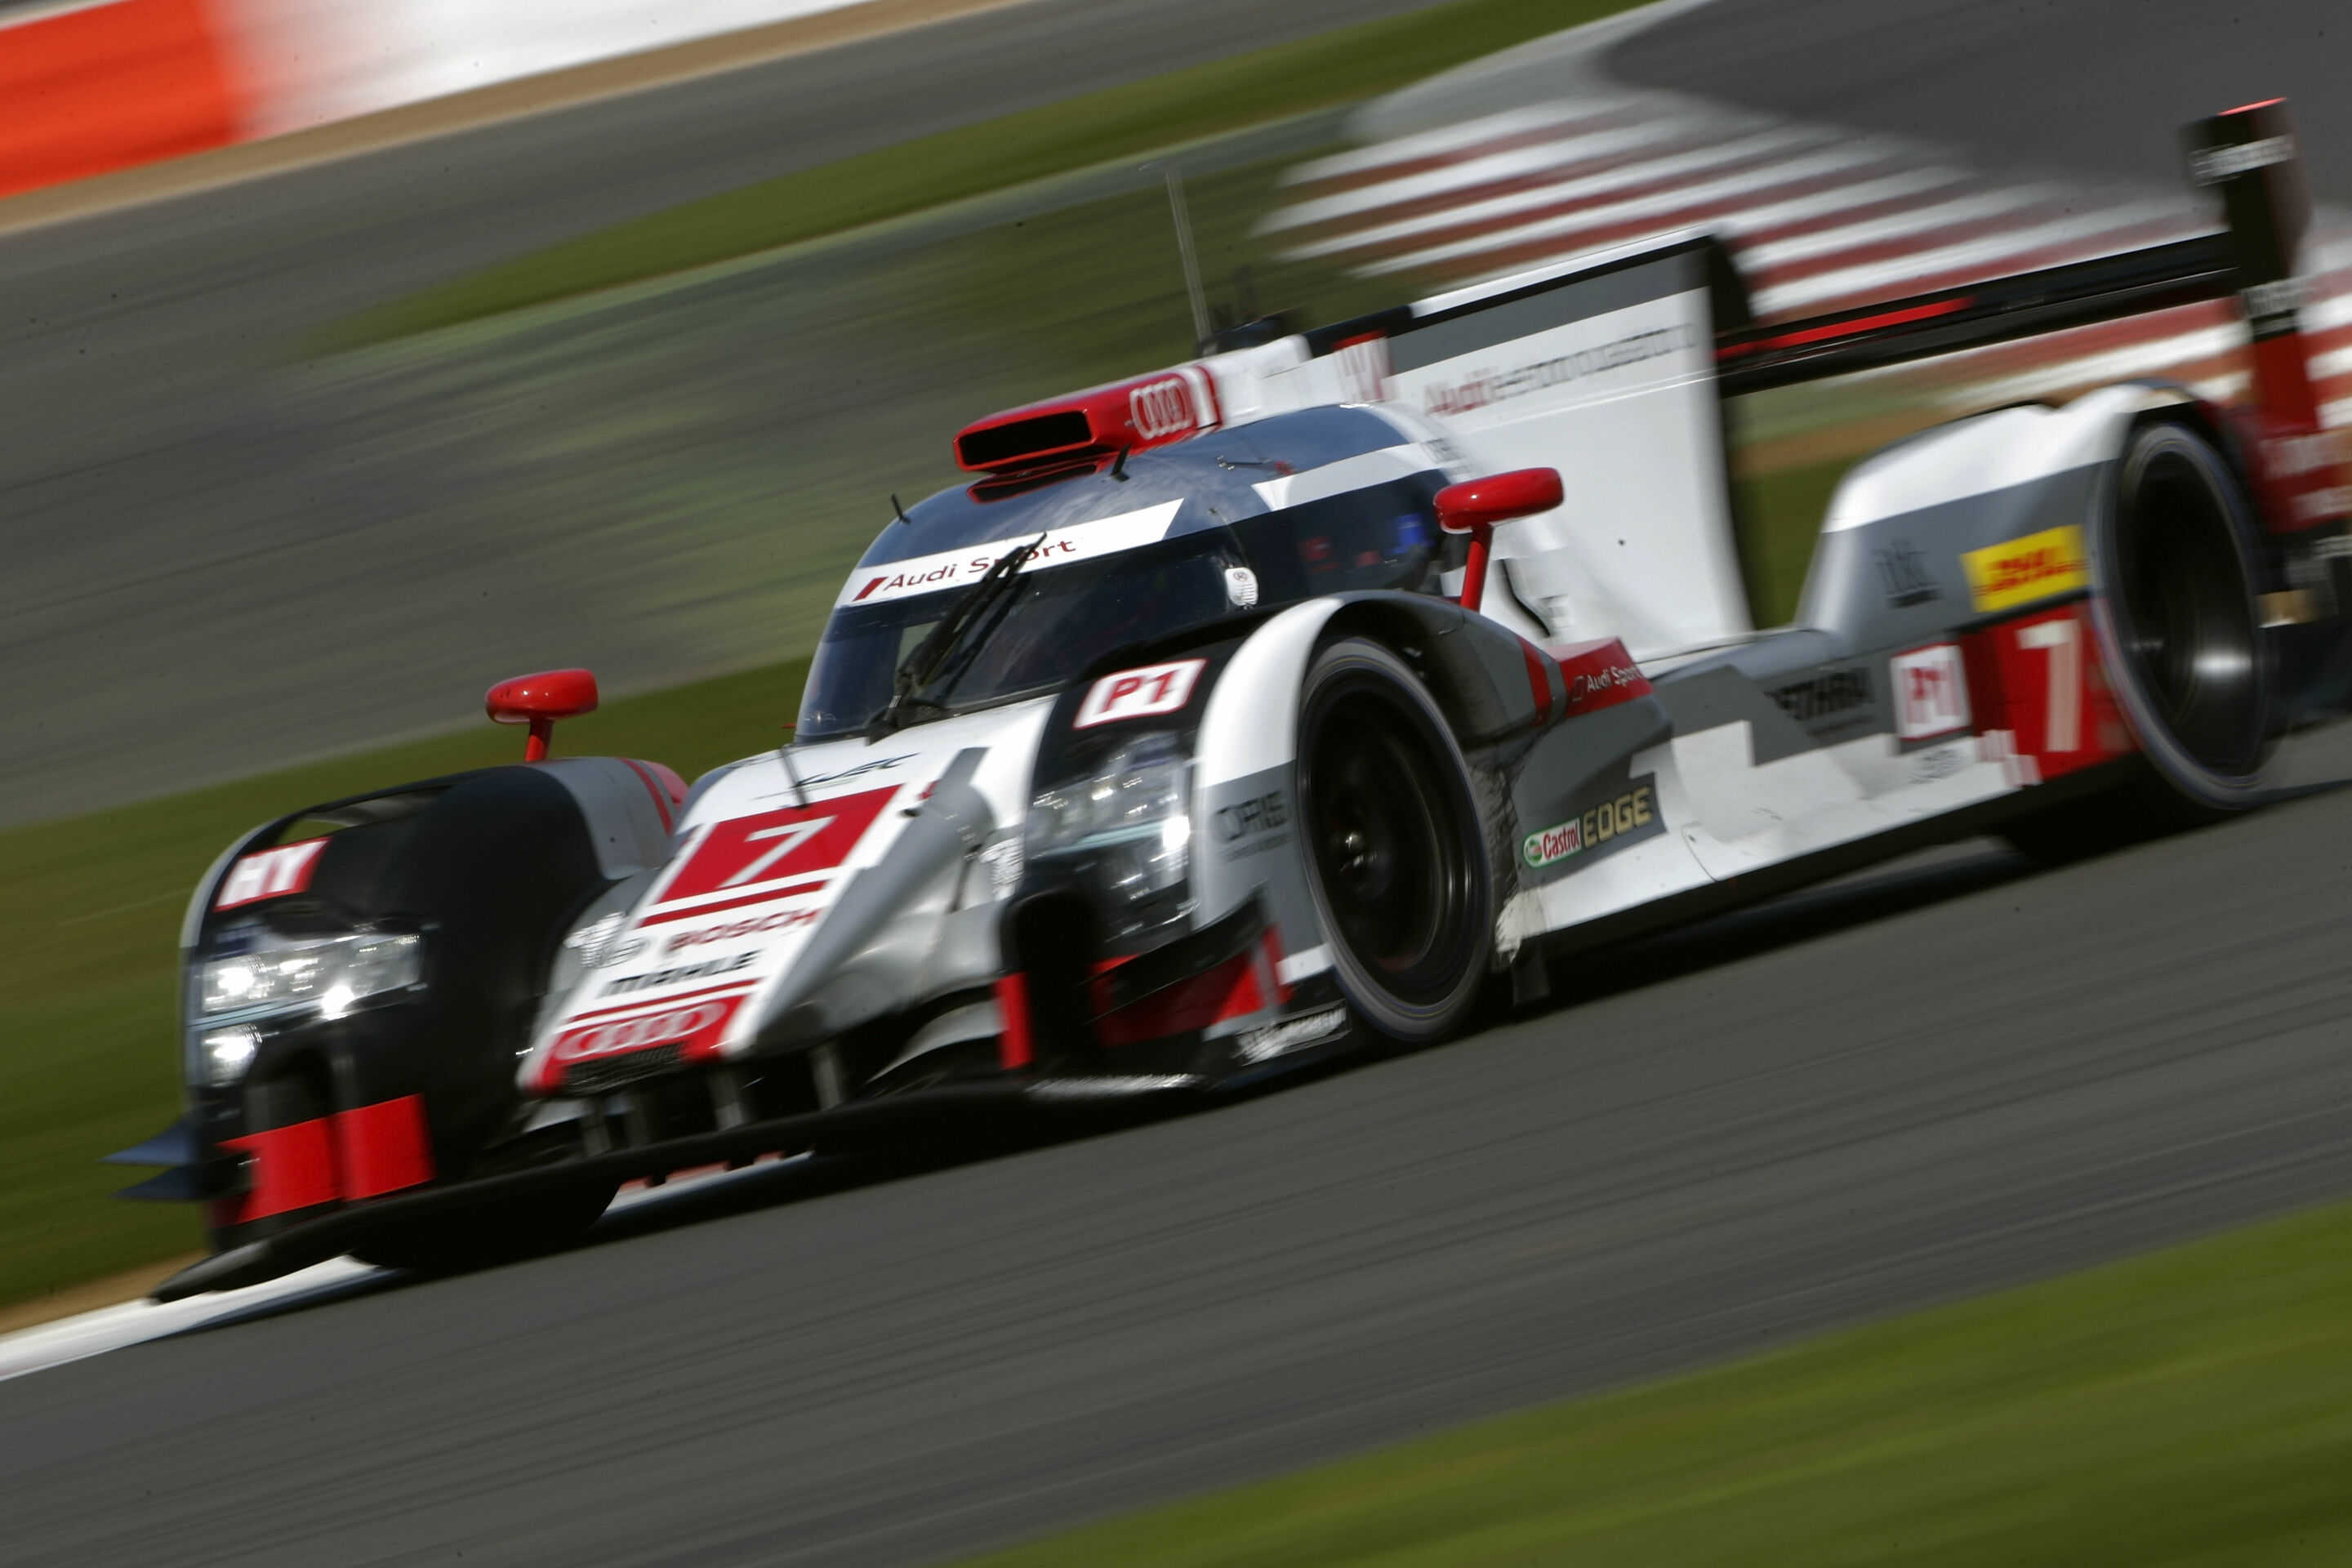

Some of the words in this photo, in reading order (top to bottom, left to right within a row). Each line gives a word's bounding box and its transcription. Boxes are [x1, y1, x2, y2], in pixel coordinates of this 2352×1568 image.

[883, 564, 957, 590] Audi
[1098, 670, 1181, 714] P1
[1587, 668, 1611, 693] Audi
[1543, 822, 1579, 860] Castrol
[1583, 784, 1654, 849] EDGE
[715, 815, 839, 889] 7
